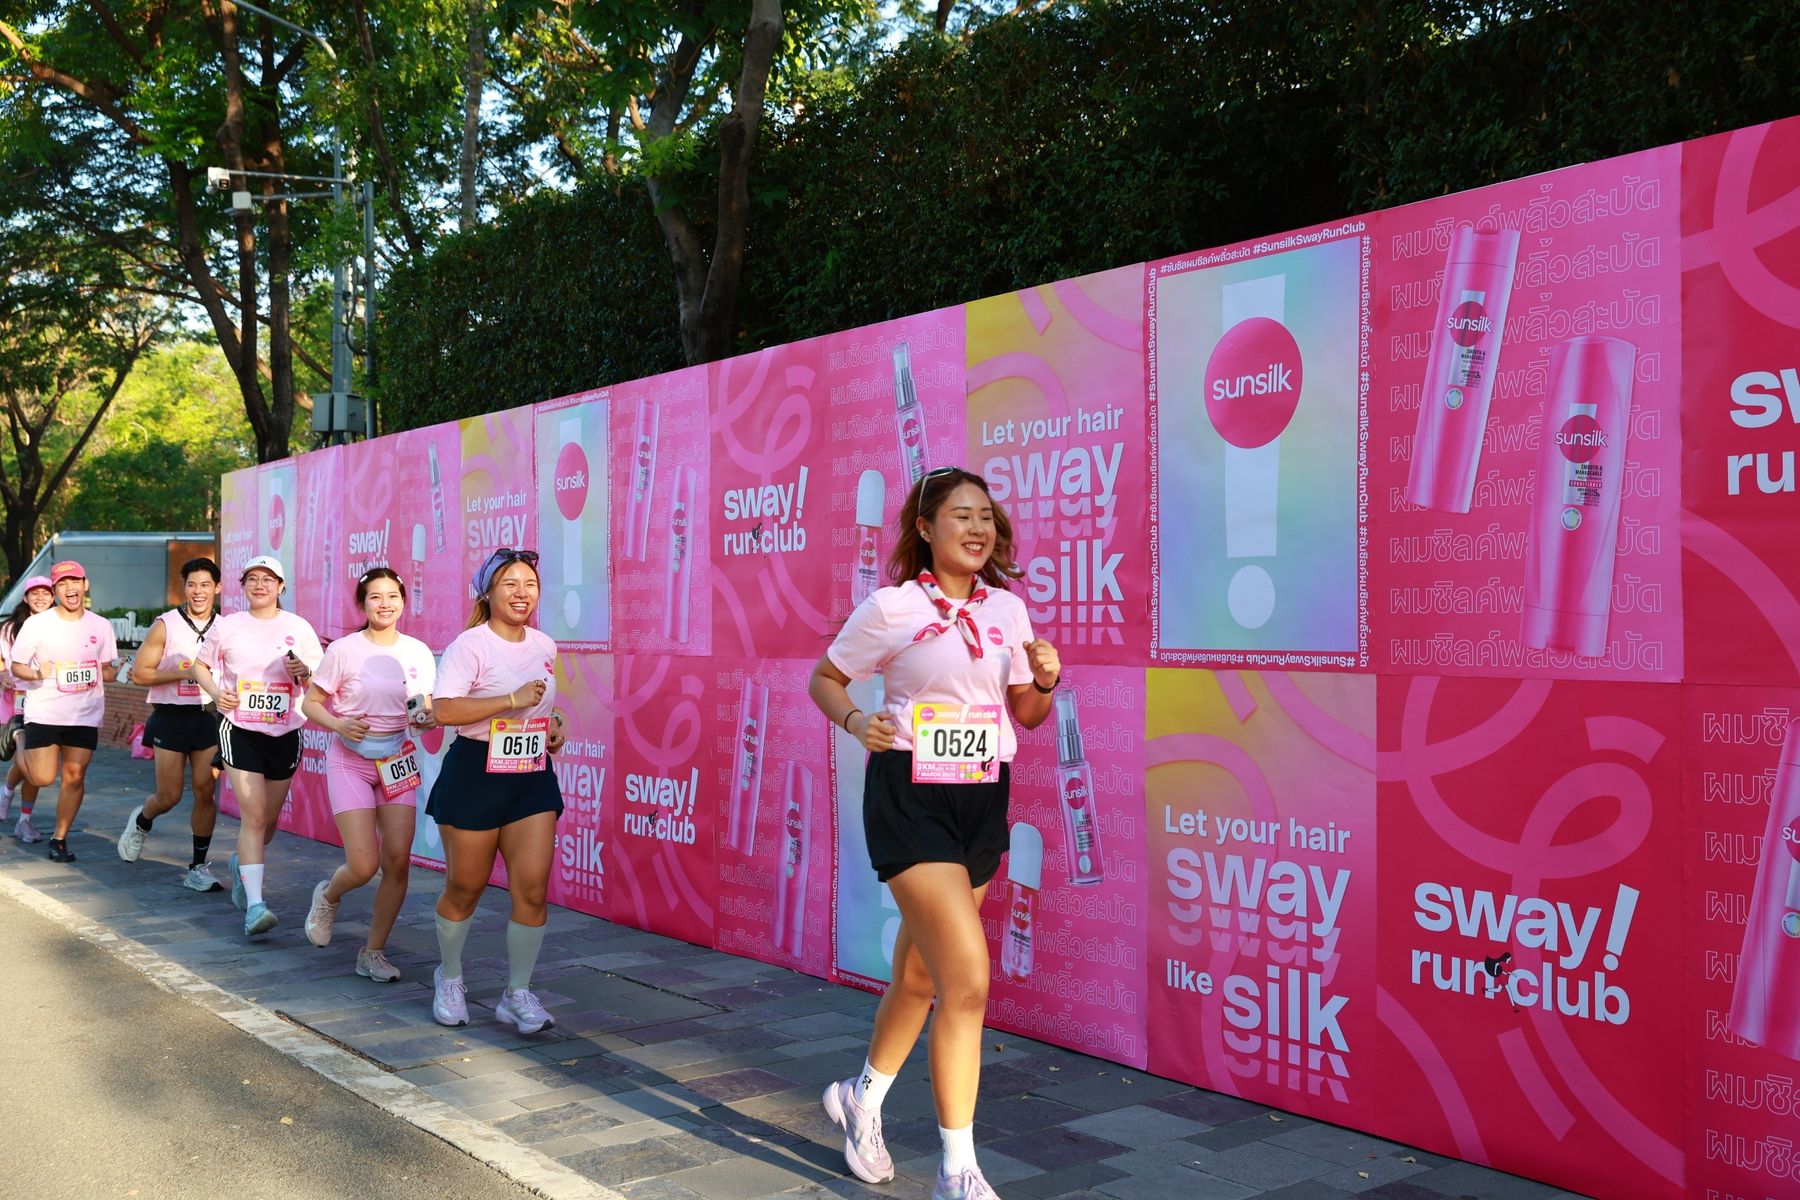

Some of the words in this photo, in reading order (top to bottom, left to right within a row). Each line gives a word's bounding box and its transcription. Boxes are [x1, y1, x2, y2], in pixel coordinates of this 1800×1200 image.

[1253, 221, 1366, 254] #SunsilkSwayRunClub
[1148, 267, 1157, 402] #SunsilkSwayRunClub
[1447, 315, 1493, 333] sunsilk
[1212, 362, 1293, 401] sunsilk
[982, 418, 1015, 447] Let
[1020, 415, 1072, 447] your
[1077, 403, 1124, 435] hair
[1555, 430, 1608, 448] sunsilk
[1360, 371, 1370, 523] #SunsilkSwayRunClub
[556, 470, 585, 491] sunsilk
[983, 441, 1124, 506] sway
[467, 496, 480, 513] Let
[484, 493, 505, 514] your
[506, 489, 527, 509] hair
[723, 465, 809, 525] sway!
[349, 518, 390, 558] sway!
[467, 513, 527, 551] sway
[724, 531, 757, 556] run
[763, 521, 806, 554] club
[1027, 539, 1124, 602] silk
[1150, 525, 1159, 659] #SunsilkSwayRunClub
[66, 670, 91, 683] 0519
[1246, 653, 1356, 668] #SunsilkSwayRunClub
[248, 694, 282, 710] 0532
[503, 735, 539, 755] 0516
[585, 739, 605, 759] hair
[934, 728, 987, 757] 0524
[390, 755, 417, 780] 0518
[554, 762, 605, 808] way
[625, 766, 699, 817] sway!
[624, 813, 652, 837] run
[655, 814, 696, 845] club
[1164, 804, 1207, 837] Let
[1215, 814, 1281, 845] your
[1289, 817, 1351, 854] hair
[561, 828, 605, 875] silk
[1166, 847, 1351, 938] sway
[1414, 882, 1640, 971] sway!
[1165, 958, 1213, 995] like
[1223, 964, 1351, 1053] silk
[1411, 949, 1495, 1000] run
[1507, 961, 1631, 1025] club
